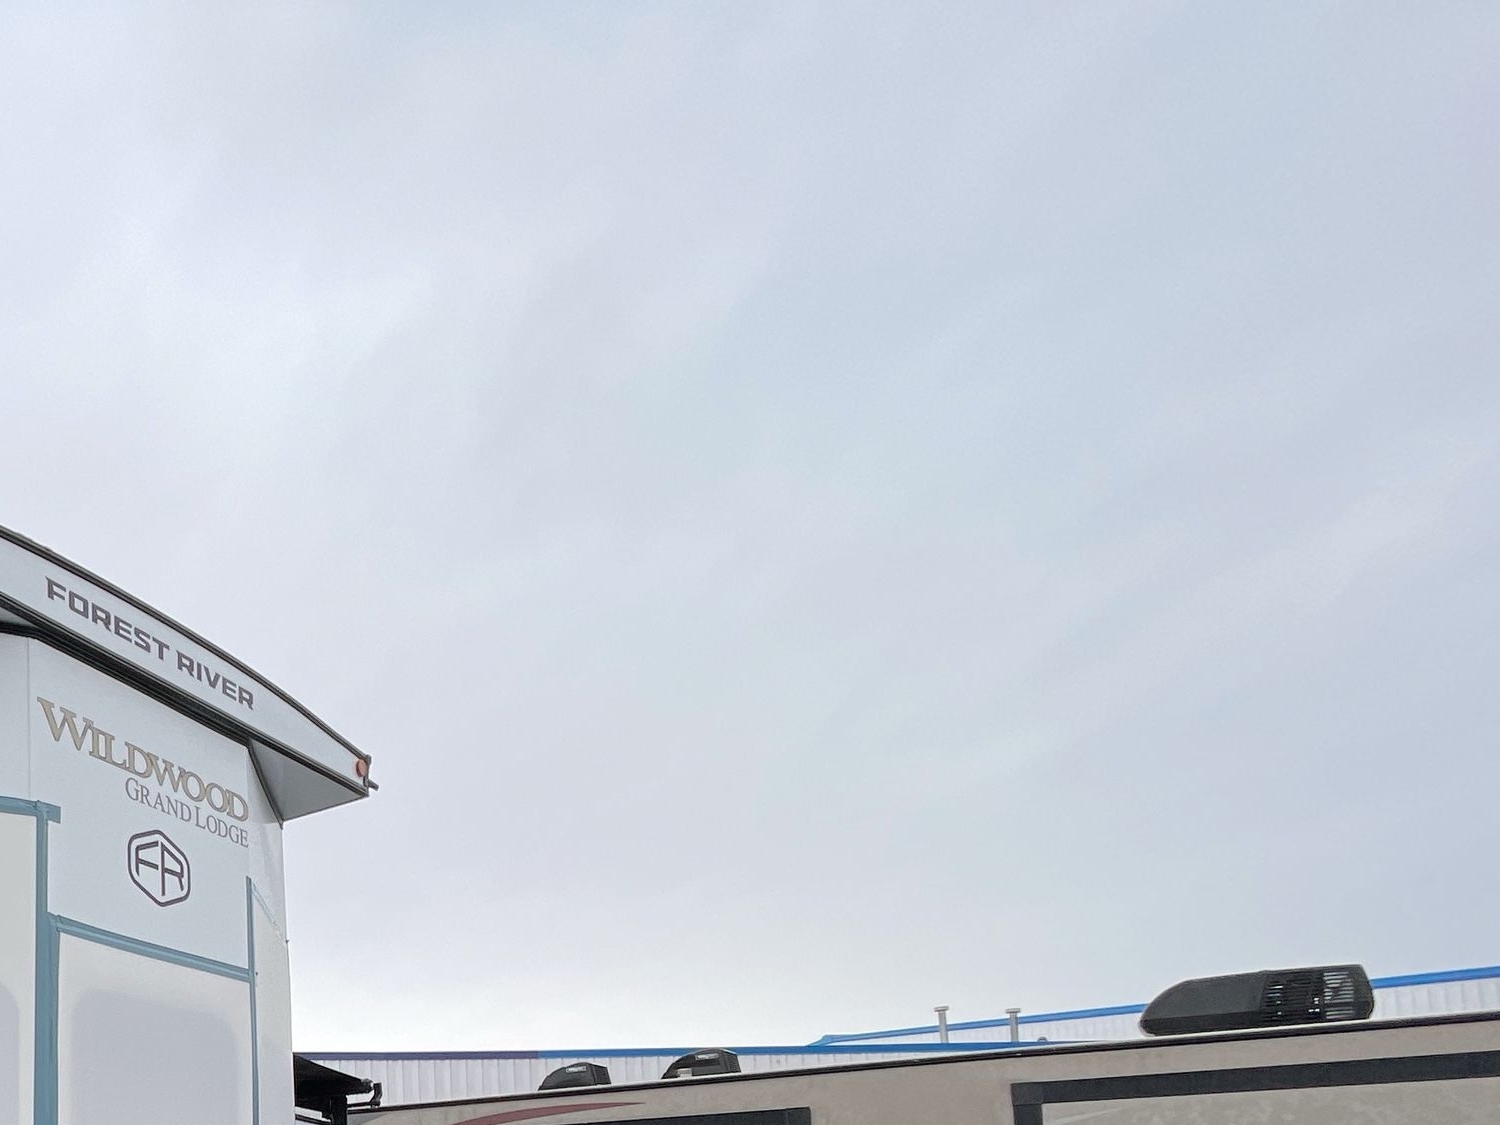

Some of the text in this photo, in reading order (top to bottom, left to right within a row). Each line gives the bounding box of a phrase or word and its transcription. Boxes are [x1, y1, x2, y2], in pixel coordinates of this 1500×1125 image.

[45, 576, 254, 711] FOREST RIVER
[37, 695, 249, 823] WILDWOOD
[125, 777, 249, 849] GRAND LODGE
